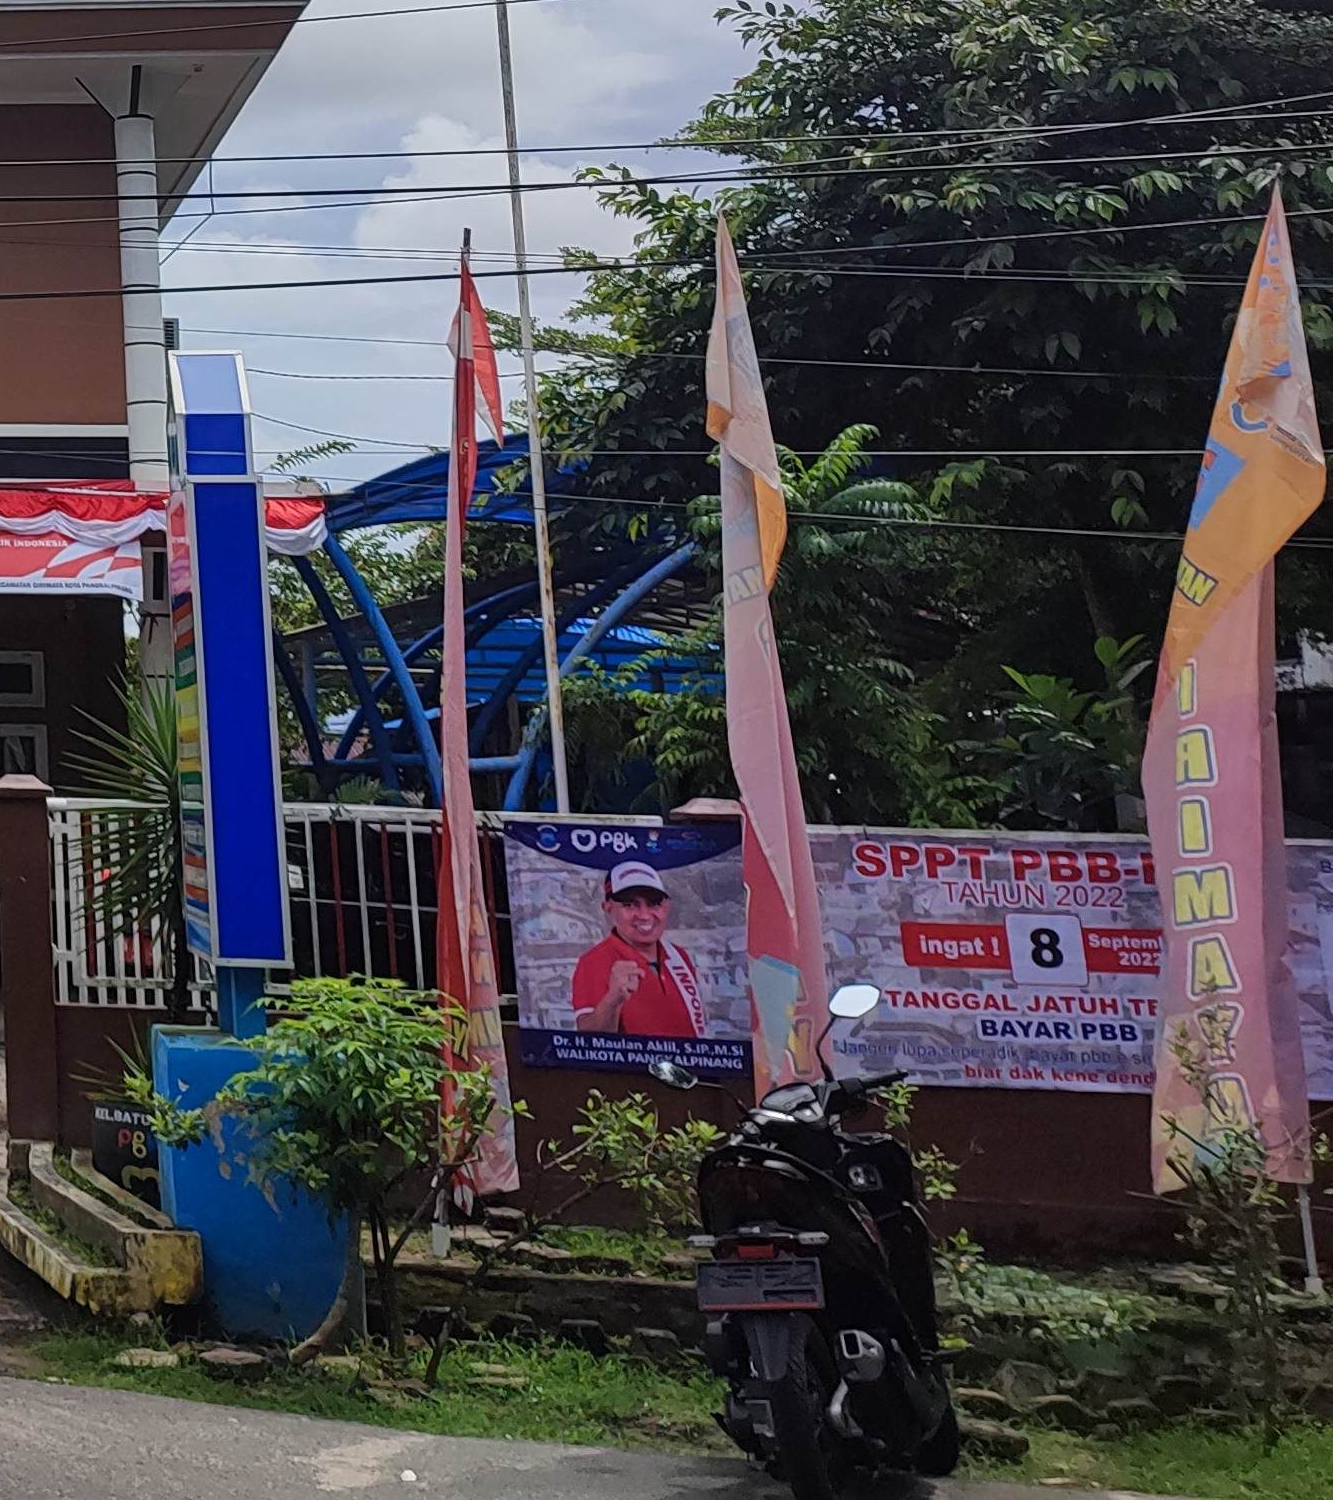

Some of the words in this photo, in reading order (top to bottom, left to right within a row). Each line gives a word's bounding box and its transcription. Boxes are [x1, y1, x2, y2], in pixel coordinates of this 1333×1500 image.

[14, 539, 69, 549] INDONESIA
[856, 843, 992, 880] SPPT
[942, 881, 1046, 907] TAHUN
[1055, 885, 1125, 909] 2022
[919, 934, 986, 960] ingat
[1030, 928, 1064, 968] 8
[1088, 933, 1162, 951] Septem
[885, 990, 1018, 1012] TANGGAL
[1026, 995, 1119, 1016] JATUH
[553, 1035, 572, 1047] Dr.
[575, 1038, 589, 1048] H.
[592, 1037, 643, 1051] Maulan
[980, 1018, 1071, 1041] BAYAR
[1080, 1023, 1139, 1043] PBB
[556, 1049, 626, 1063] WALIKOTA
[964, 1064, 1002, 1079] biar
[1009, 1066, 1045, 1081] dak
[1050, 1068, 1099, 1084] kene
